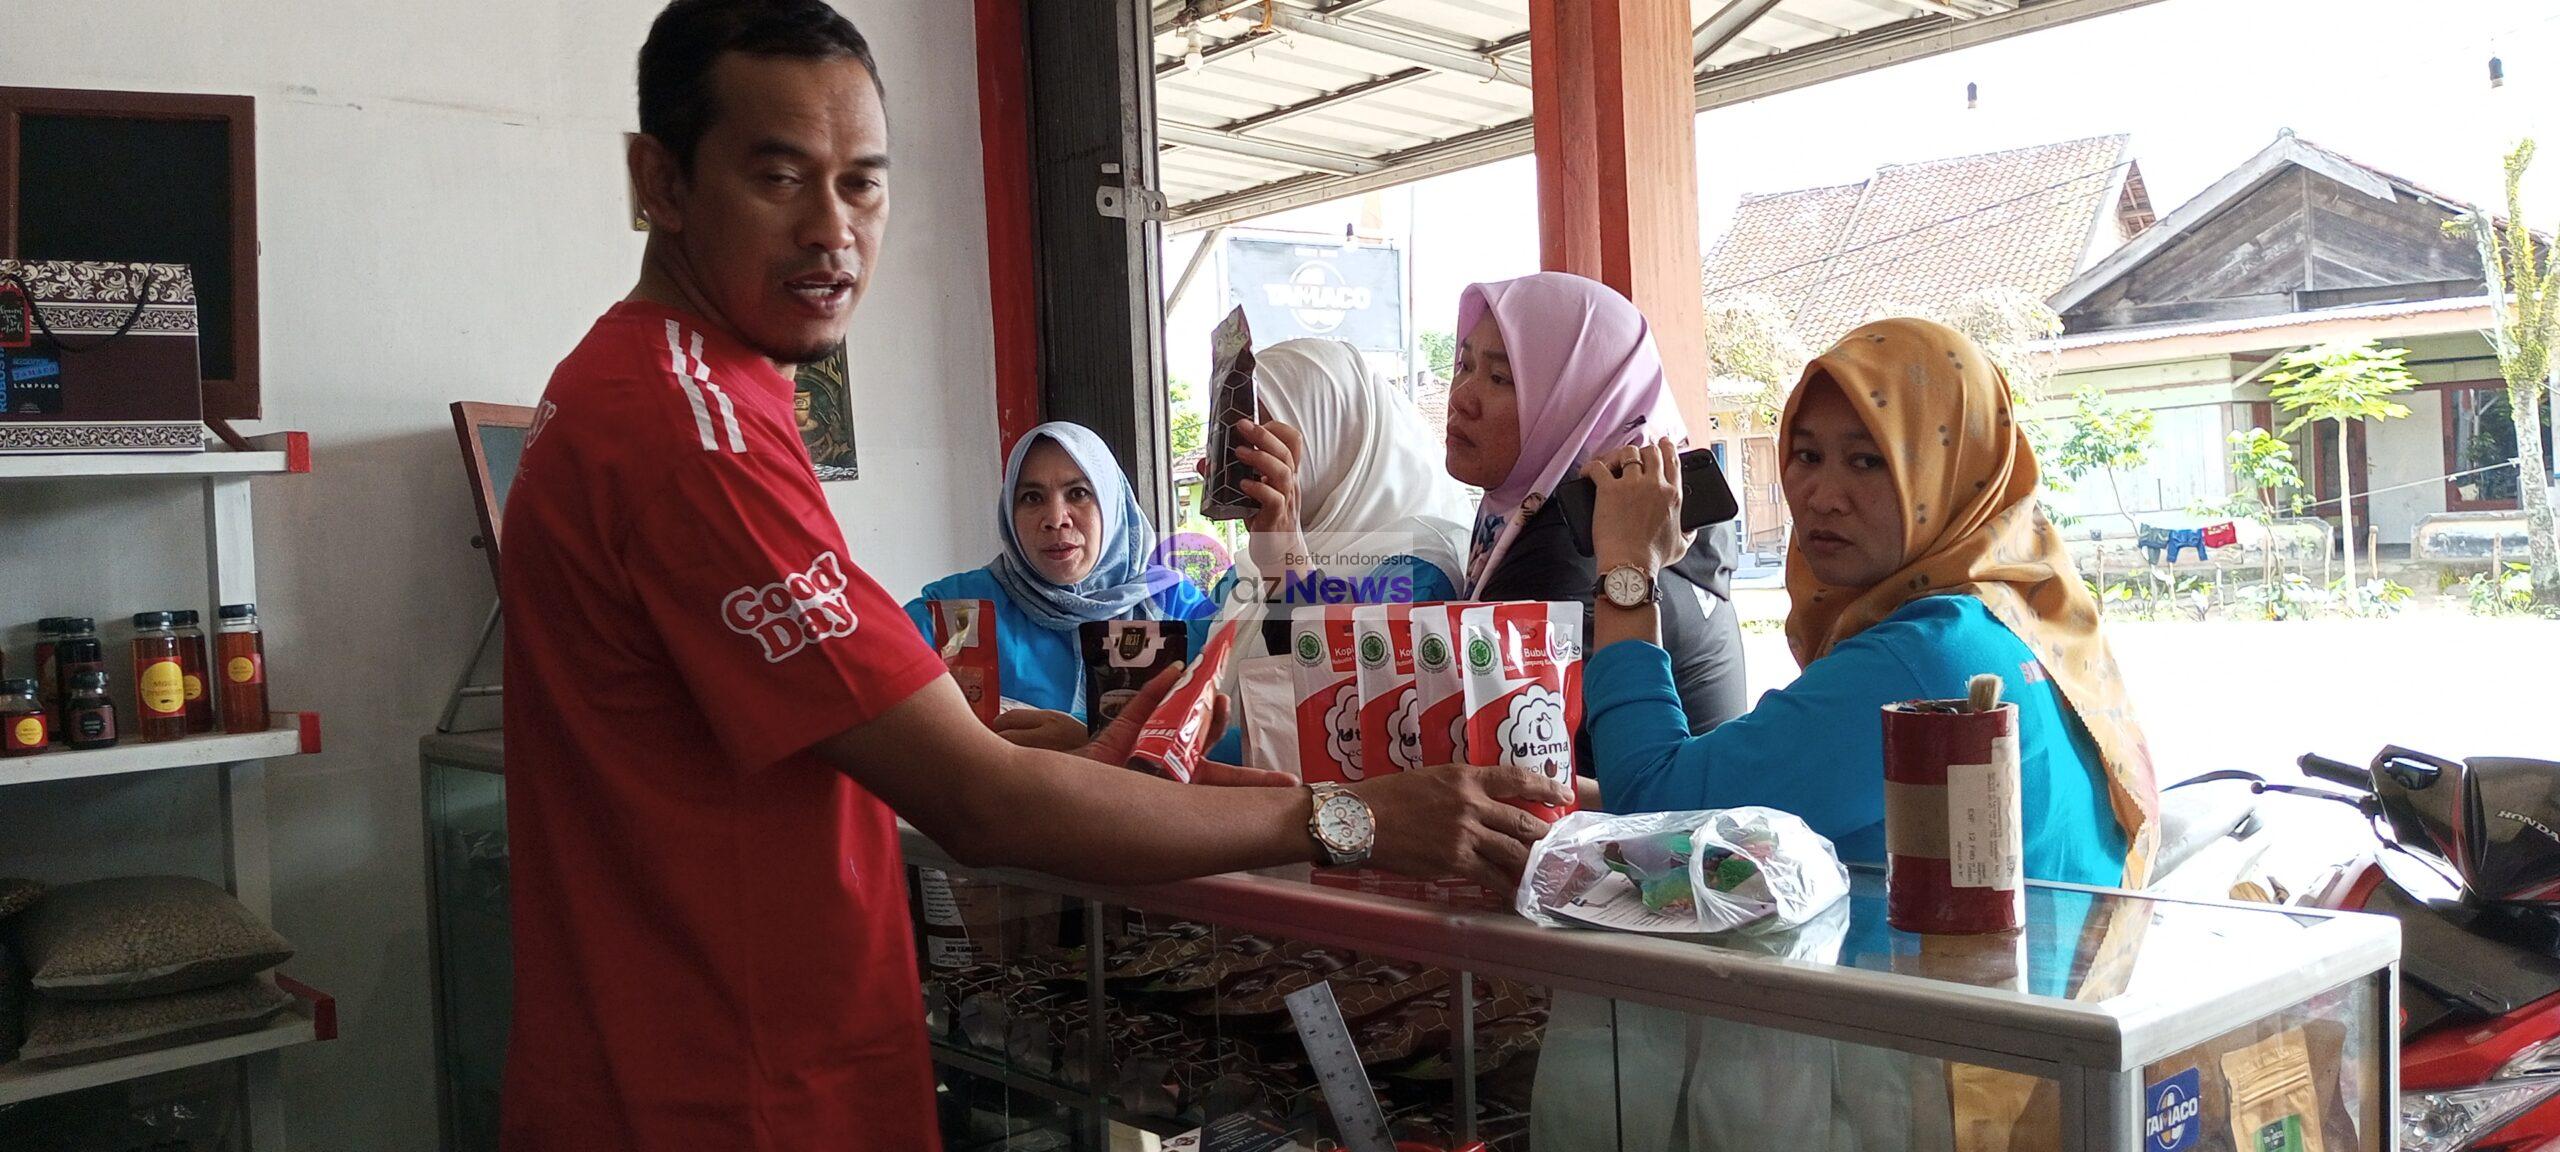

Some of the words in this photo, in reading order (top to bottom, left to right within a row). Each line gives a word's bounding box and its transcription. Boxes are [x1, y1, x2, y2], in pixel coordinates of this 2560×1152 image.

[1263, 284, 1372, 310] TAMACO
[721, 551, 848, 634] Good
[756, 593, 858, 663] Day
[1524, 647, 1547, 657] Bubu
[1513, 741, 1569, 758] Utama
[2497, 810, 2560, 844] HONDA
[2146, 1097, 2199, 1137] TAMACO
